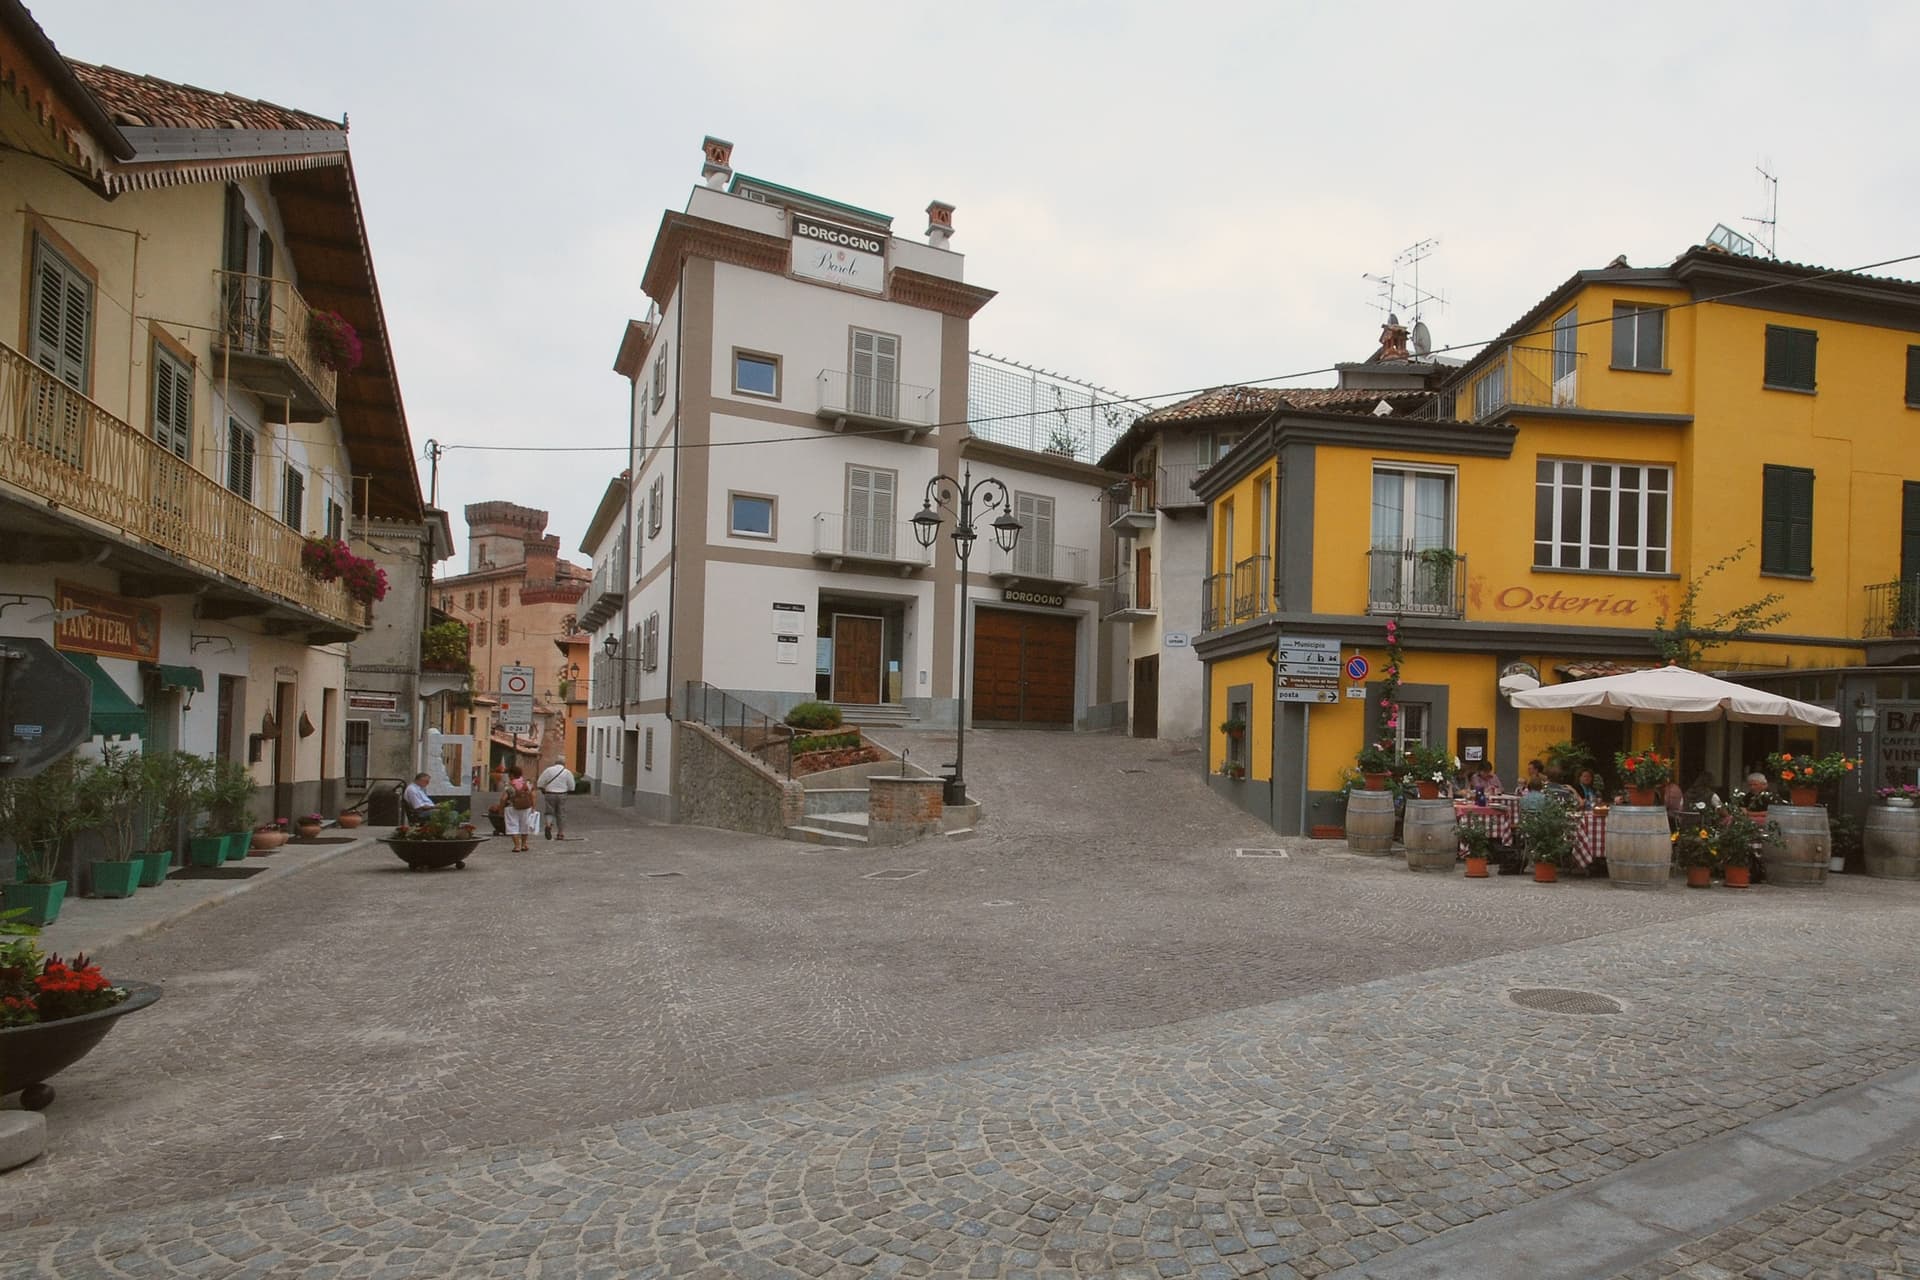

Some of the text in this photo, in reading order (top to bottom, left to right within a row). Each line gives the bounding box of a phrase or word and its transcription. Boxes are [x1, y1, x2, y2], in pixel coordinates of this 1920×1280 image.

[798, 223, 880, 252] BORGOGNO
[816, 249, 858, 276] Barolo
[1006, 591, 1063, 605] BORGOGNO
[1494, 586, 1641, 615] Osteria
[61, 597, 131, 646] PANETTERIA
[1294, 641, 1326, 649] Municipio
